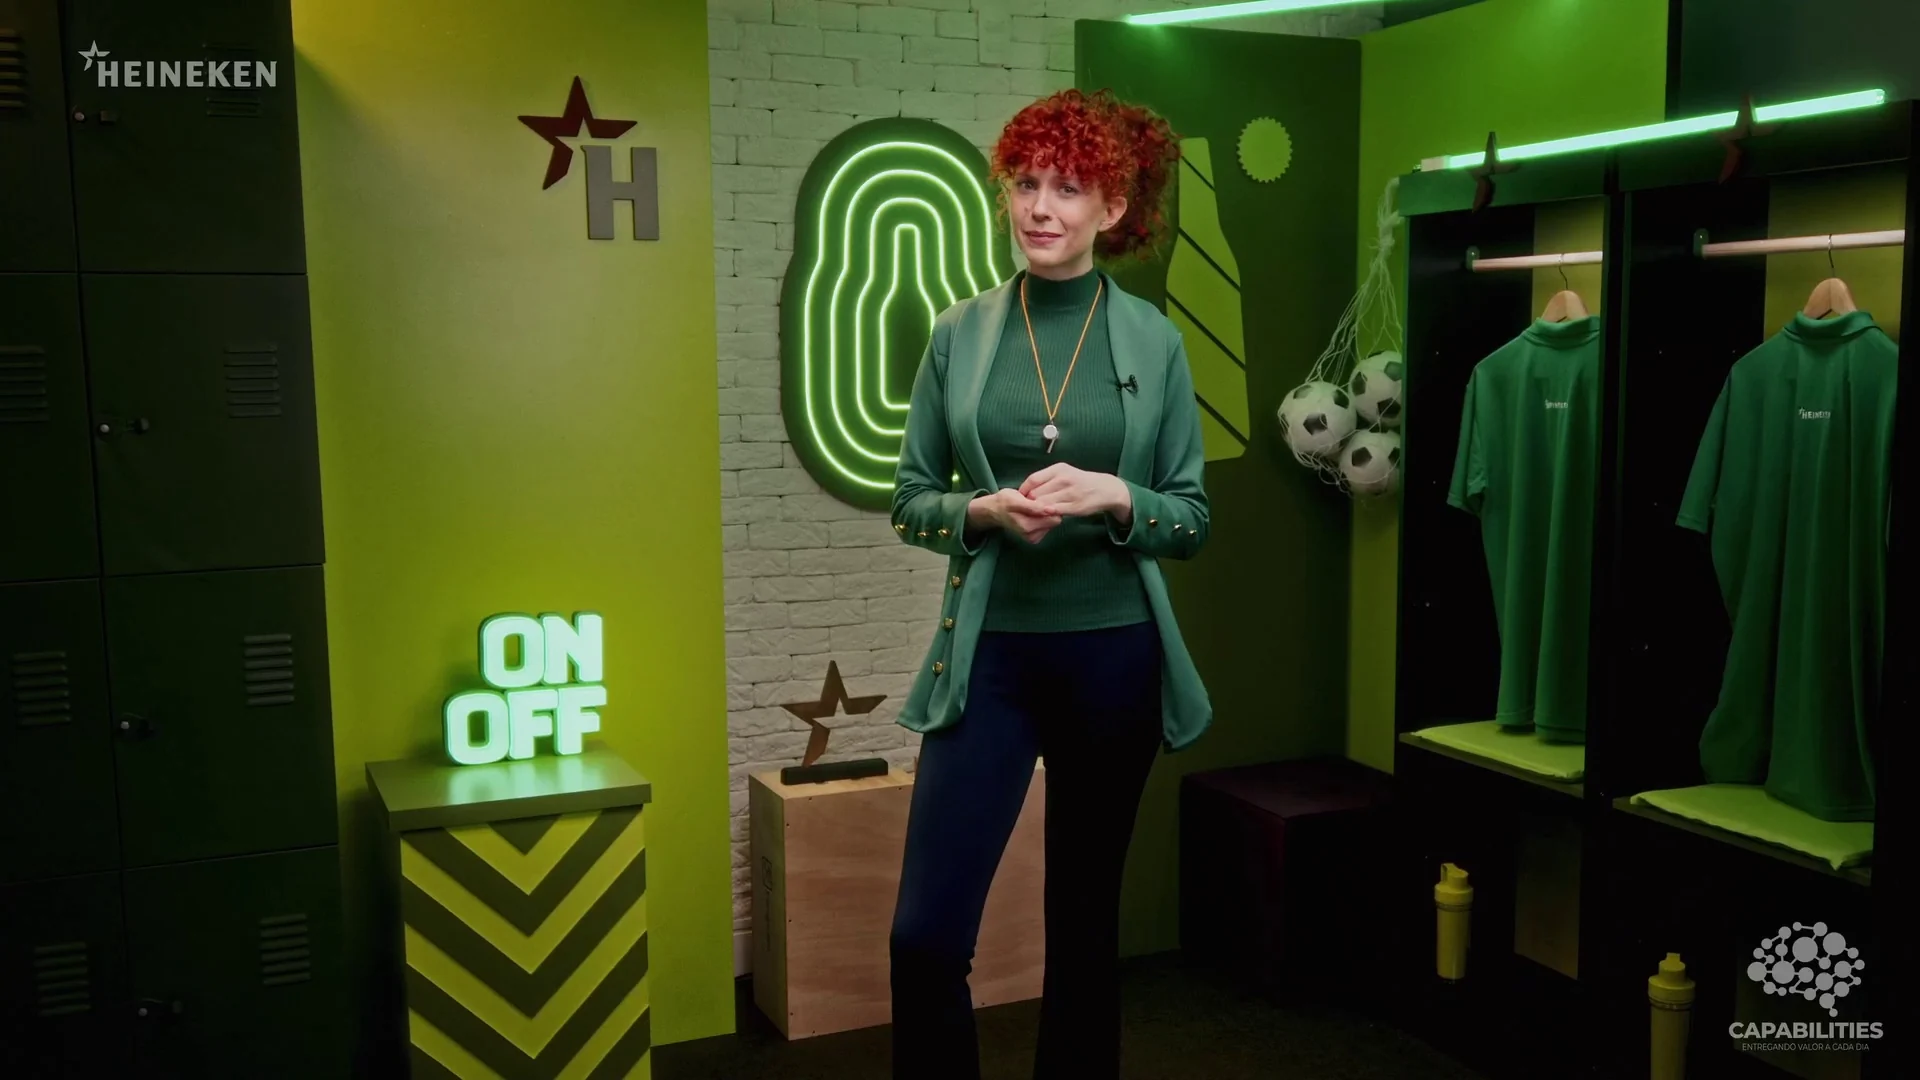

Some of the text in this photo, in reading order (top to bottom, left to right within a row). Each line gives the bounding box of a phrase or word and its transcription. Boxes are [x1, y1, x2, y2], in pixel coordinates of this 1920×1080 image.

[580, 145, 660, 241] H
[479, 612, 604, 688] ON
[443, 685, 607, 766] OFF
